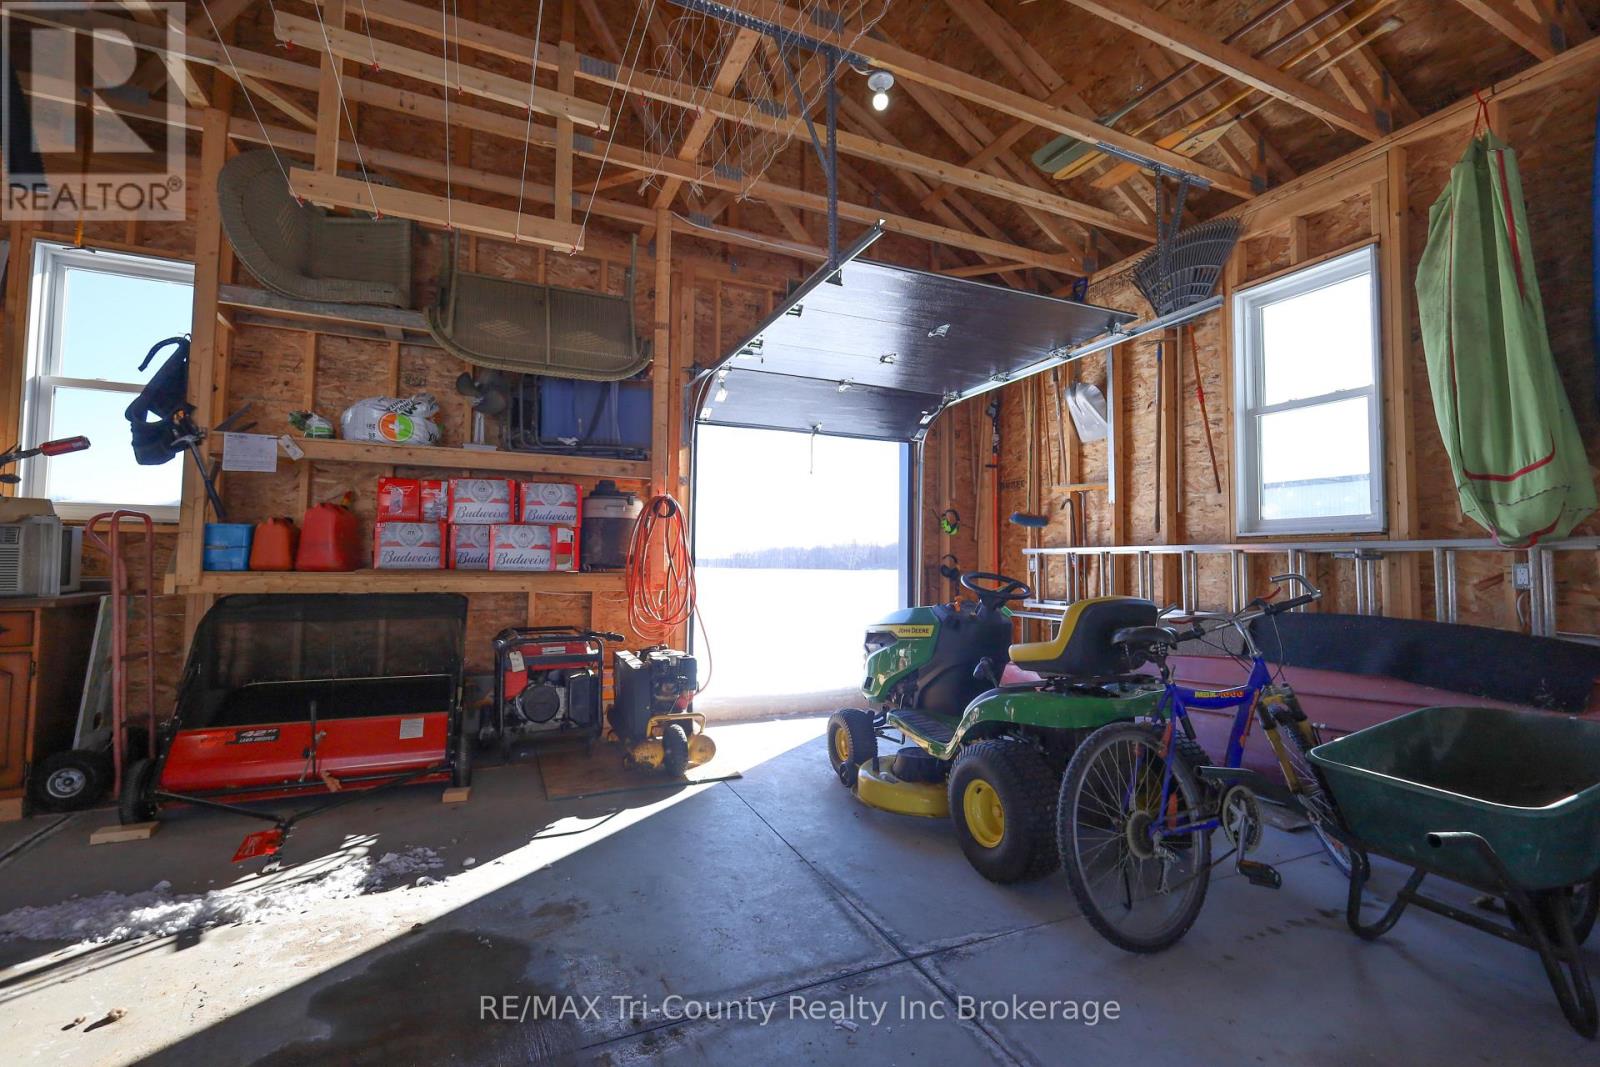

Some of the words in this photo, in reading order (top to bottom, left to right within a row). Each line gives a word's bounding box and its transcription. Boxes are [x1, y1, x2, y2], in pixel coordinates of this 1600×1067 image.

[455, 506, 509, 519] Budweiser
[526, 508, 577, 521] Budweiser
[383, 550, 440, 563] Budweiser
[496, 553, 551, 565] Budweiser
